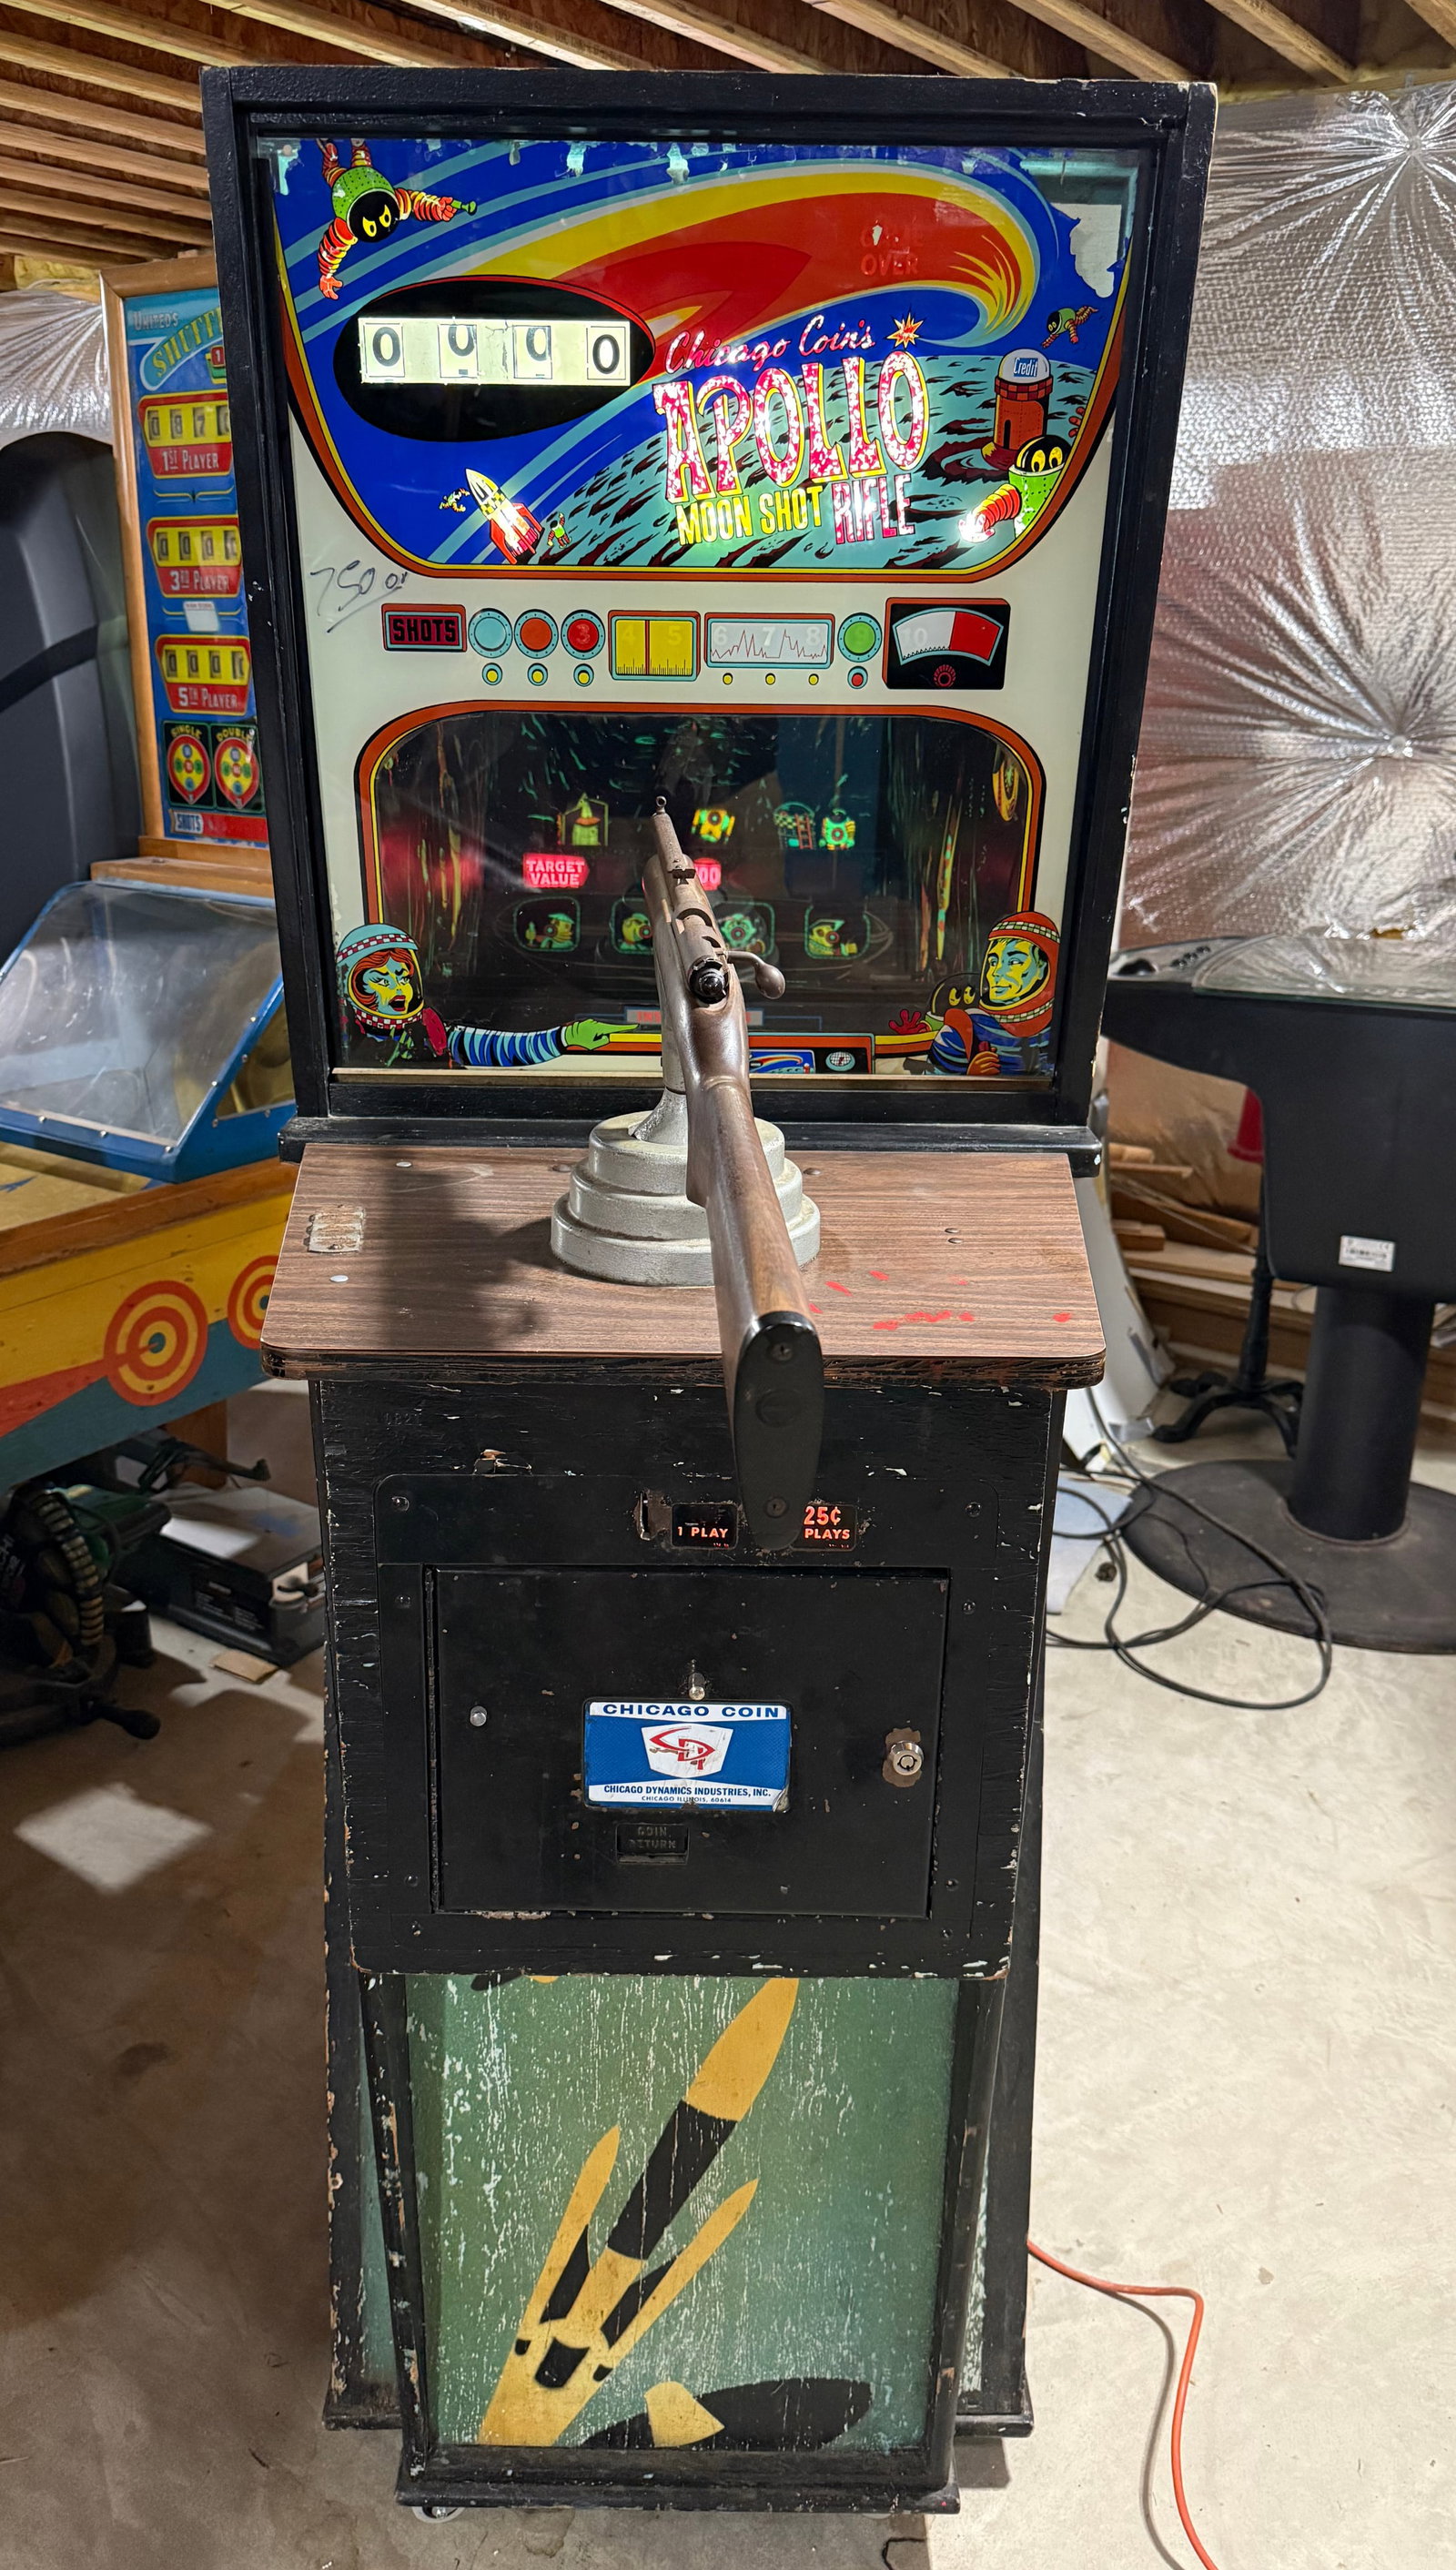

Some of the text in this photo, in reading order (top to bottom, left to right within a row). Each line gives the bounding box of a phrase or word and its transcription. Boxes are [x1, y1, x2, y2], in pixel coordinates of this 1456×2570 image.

[665, 314, 876, 374] Chicago Coin's
[1014, 357, 1038, 377] Credit
[652, 350, 930, 504] APOLLO
[182, 450, 219, 470] PLAYER
[675, 473, 915, 545] MOON SHOT RIFLE
[193, 570, 229, 591] PLAYER
[393, 619, 456, 642] SHOTS
[575, 623, 591, 644] 3
[713, 625, 821, 647] 6 7 8
[201, 688, 238, 709] PLAYER
[525, 859, 585, 874] TARGET
[530, 873, 581, 887] VALUE
[803, 1505, 842, 1527] 25¢
[677, 1526, 729, 1539] 1 PLAY
[804, 1527, 851, 1541] PLAYS
[602, 1704, 780, 1719] CHICAGO COIN
[603, 1785, 772, 1797] CHICAGO DYNAMICS INDUSTRIES, INC.
